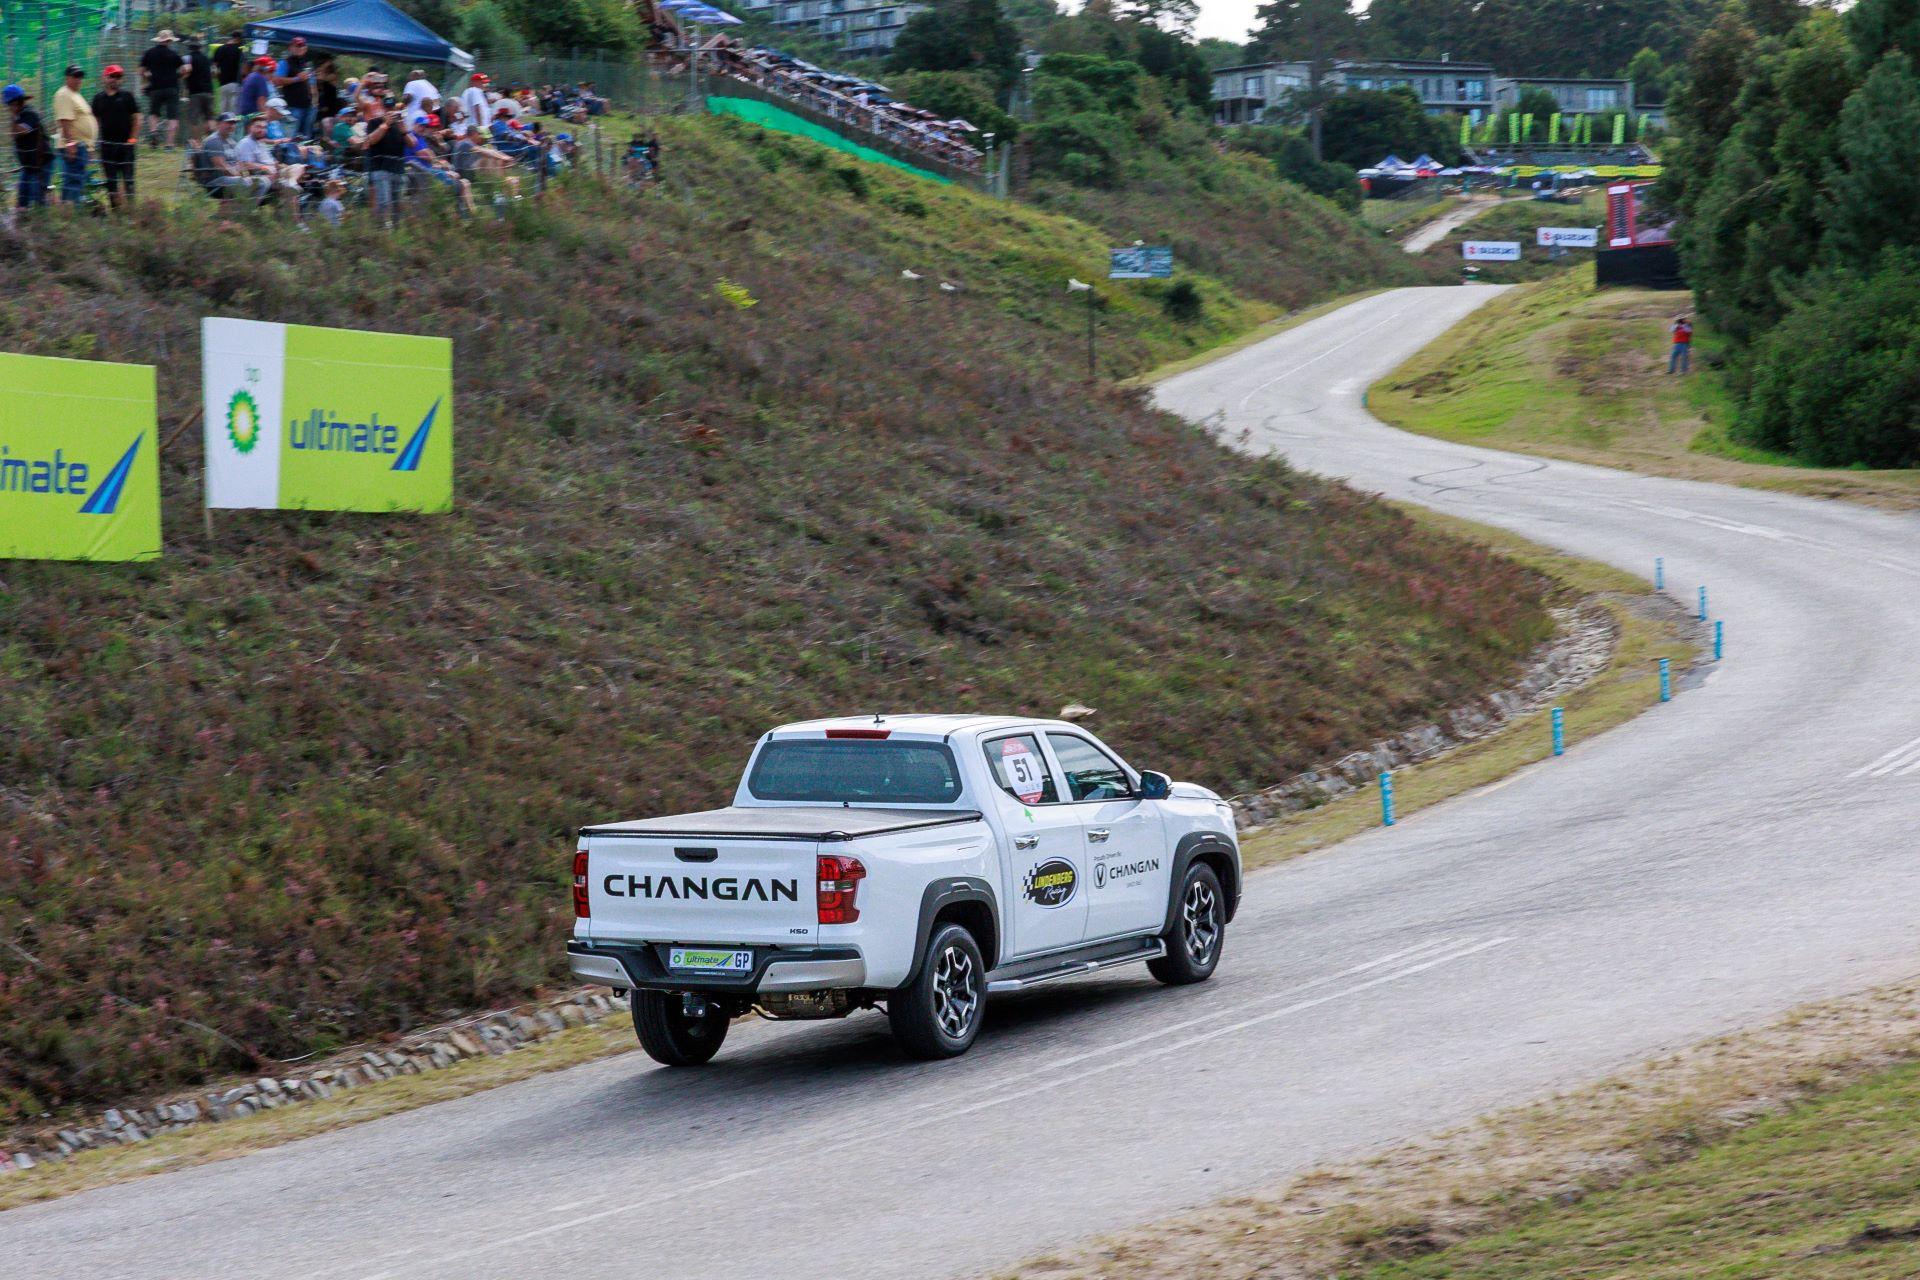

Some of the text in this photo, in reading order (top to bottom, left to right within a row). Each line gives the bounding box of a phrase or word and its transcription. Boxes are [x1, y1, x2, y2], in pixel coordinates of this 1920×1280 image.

[290, 408, 398, 454] ultimate
[1012, 757, 1033, 783] 51
[1109, 858, 1160, 880] CHANGAN
[603, 874, 798, 902] CHANGAN
[686, 952, 750, 968] ultimate GP
